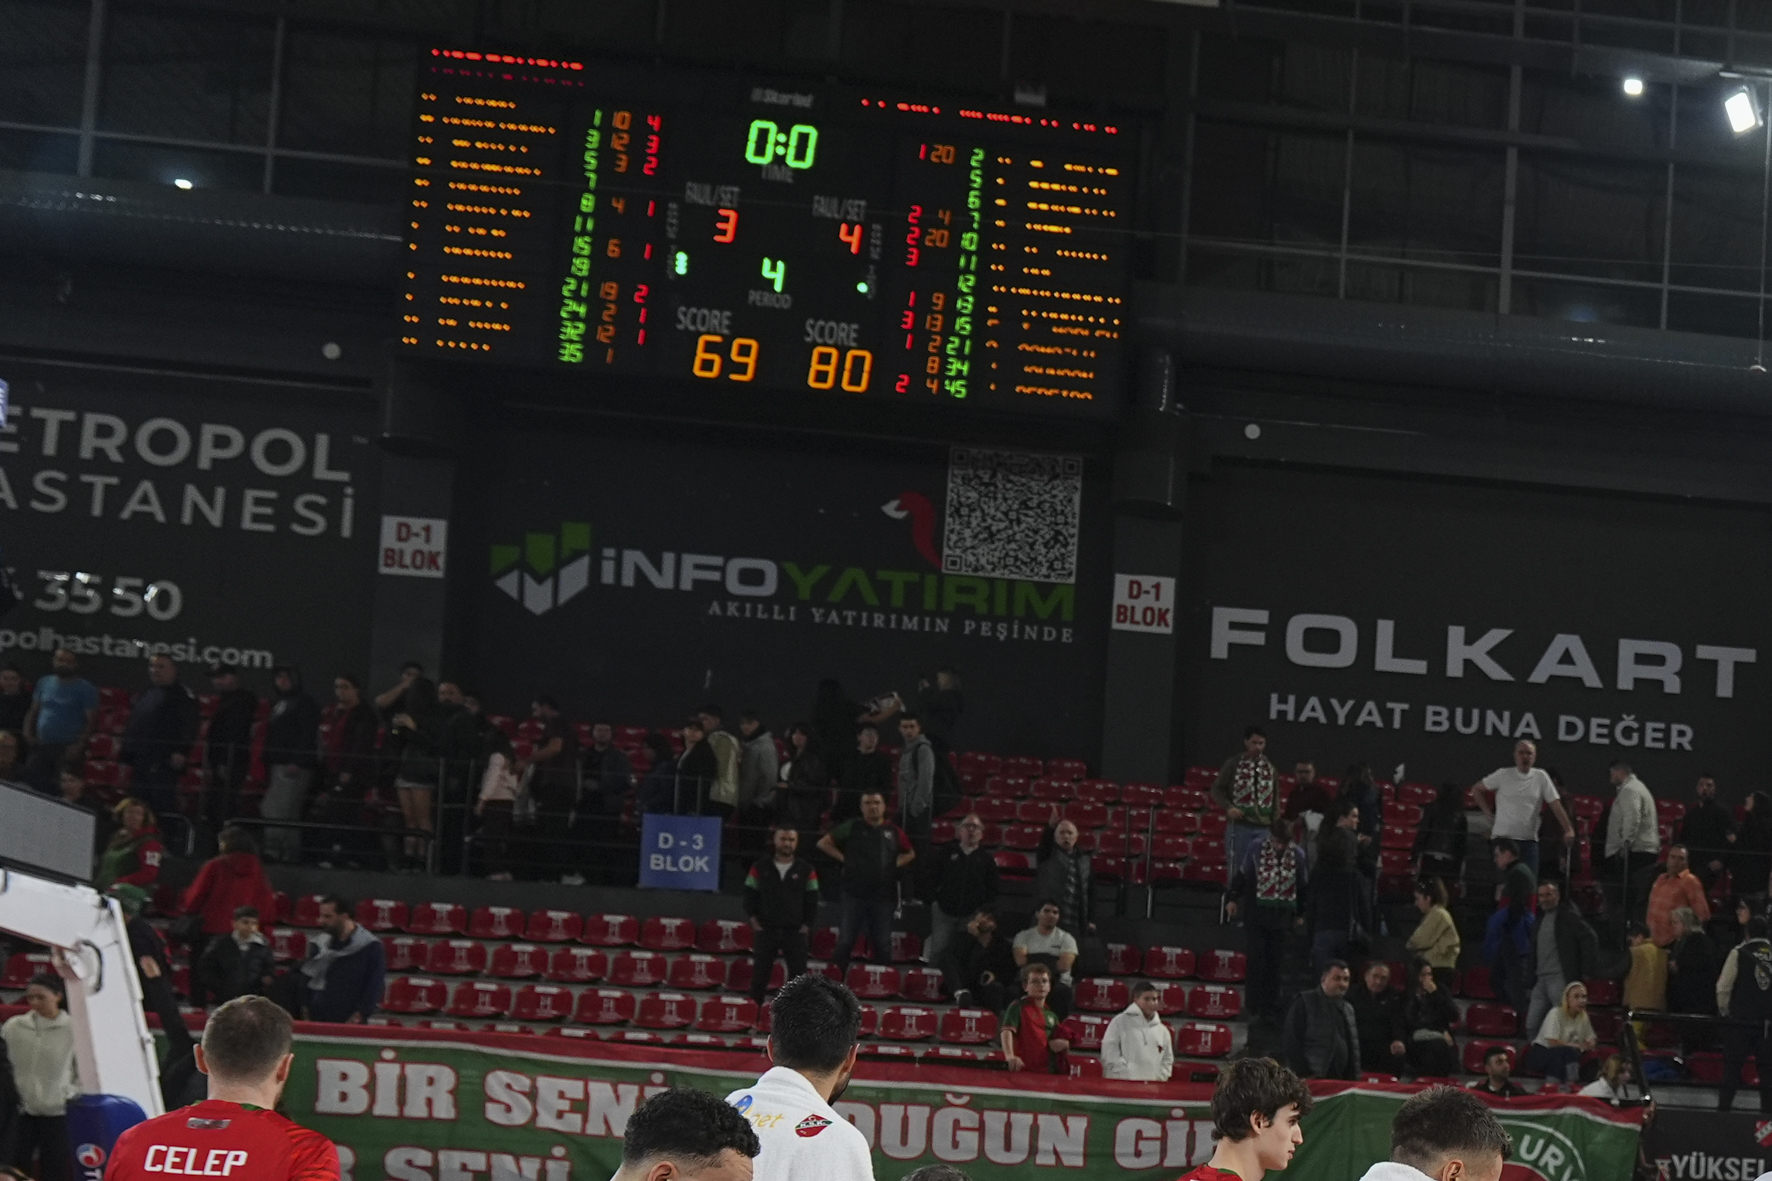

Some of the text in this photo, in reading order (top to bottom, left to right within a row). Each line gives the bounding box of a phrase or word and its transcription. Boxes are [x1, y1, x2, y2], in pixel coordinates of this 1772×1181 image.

[713, 208, 740, 244] 3
[838, 221, 864, 255] 4
[761, 256, 787, 293] 4
[676, 305, 732, 335] SCORE
[804, 318, 860, 348] SCORE
[692, 334, 760, 382] 69
[807, 345, 873, 393] 80
[395, 521, 432, 544] D-1
[382, 547, 442, 571] BLOK
[1127, 579, 1162, 601] D-1
[708, 601, 1075, 644] AKILLI YATIRIMIN PEŞİNDE
[1115, 604, 1171, 629] BLOK
[1210, 606, 1757, 699] FOLKART
[1268, 693, 1695, 752] HAYAT BUNA DEĞER
[649, 853, 710, 874] BLOK
[315, 1048, 457, 1120] BİR
[143, 1144, 249, 1177] CELEP
